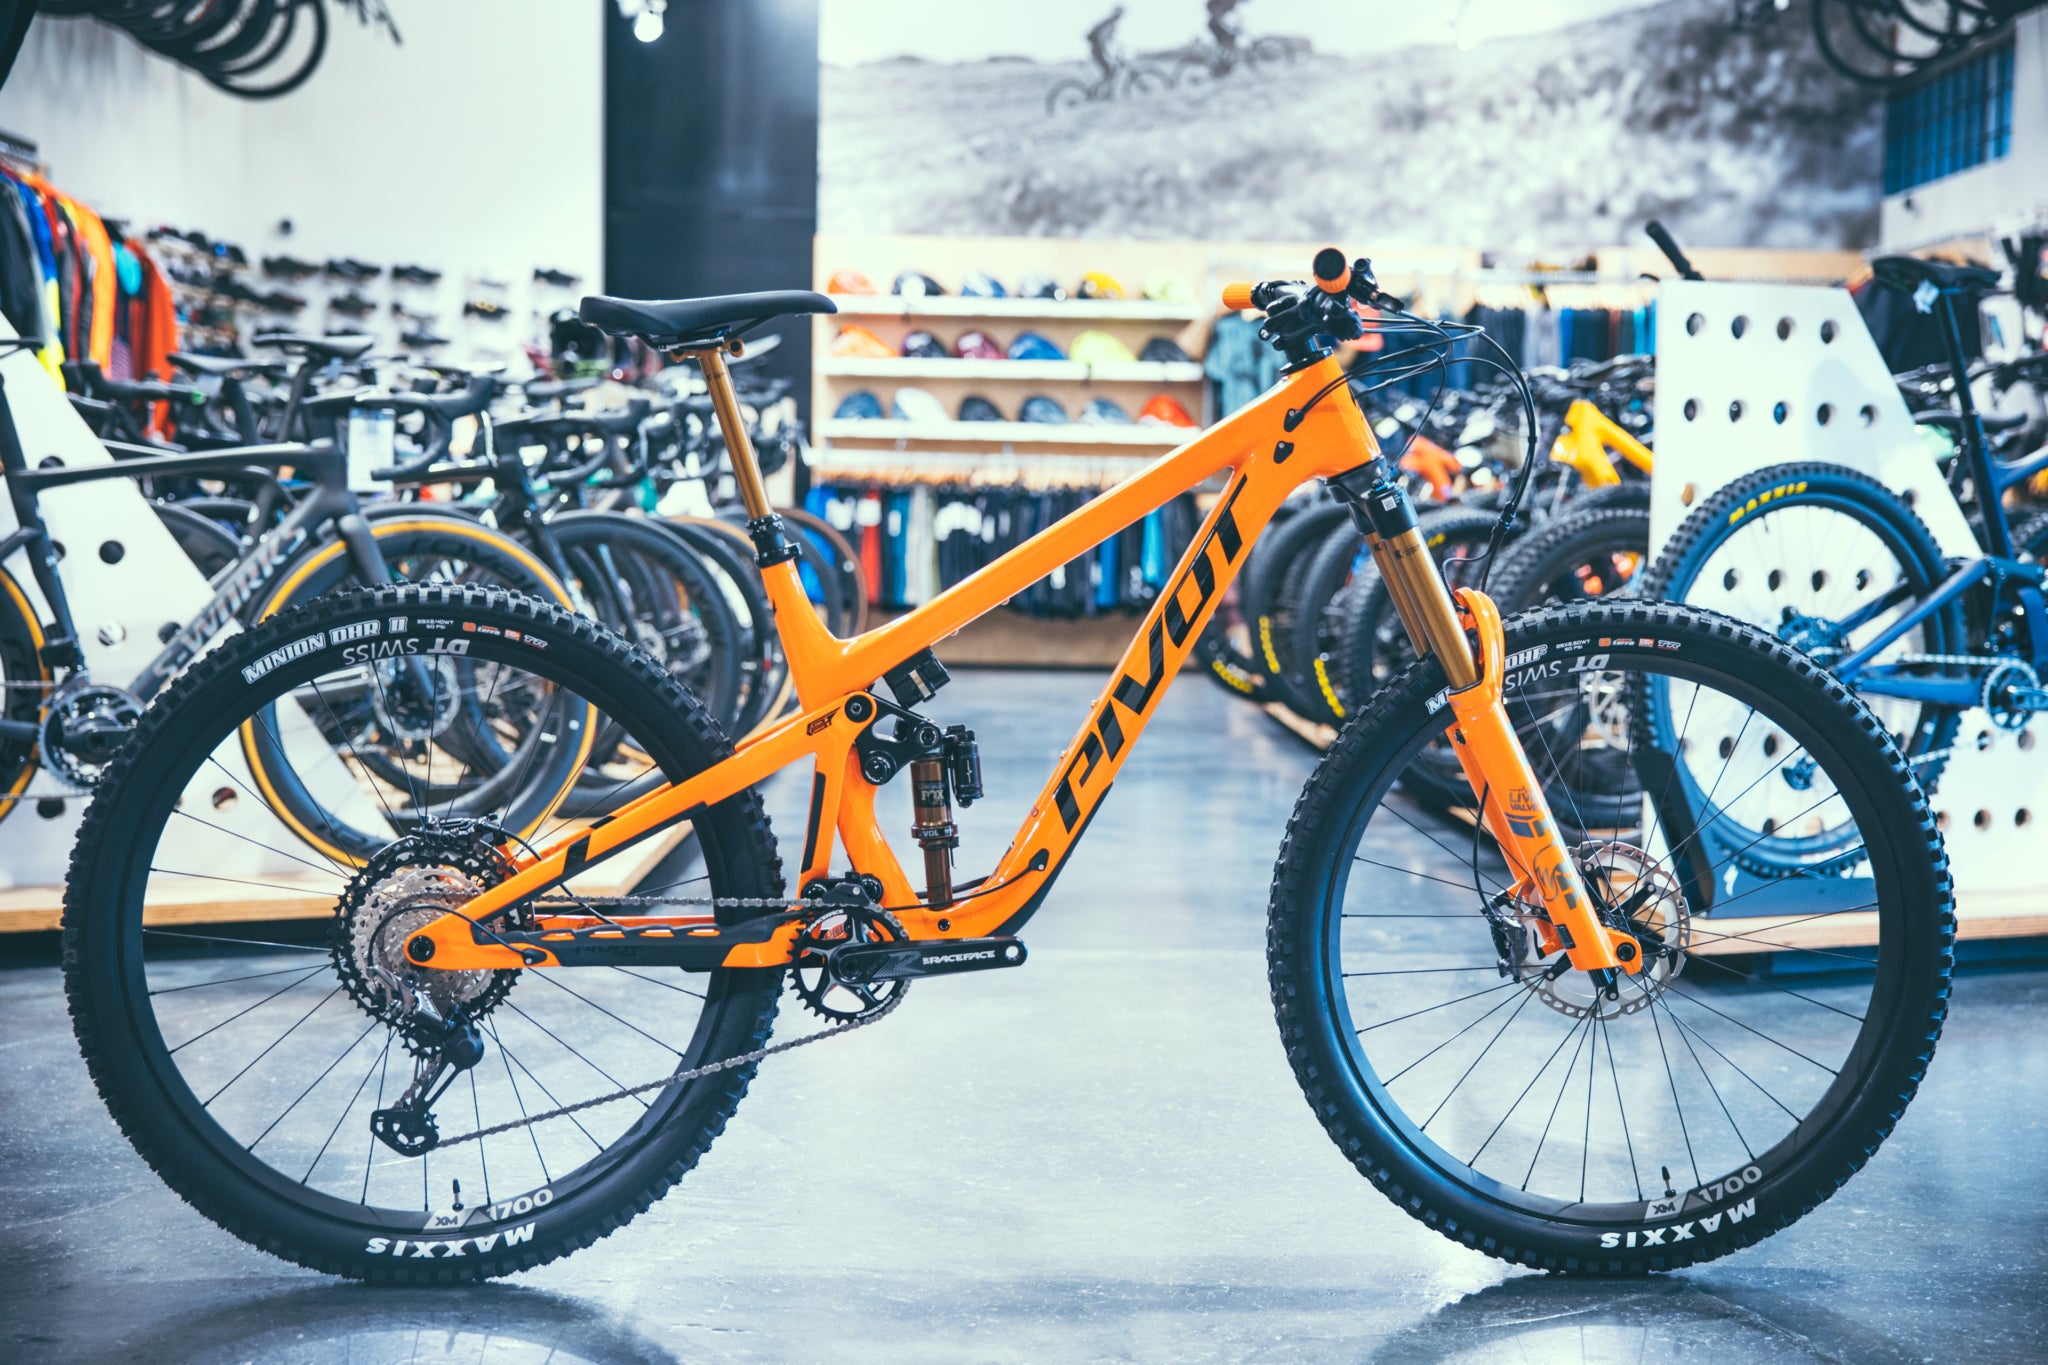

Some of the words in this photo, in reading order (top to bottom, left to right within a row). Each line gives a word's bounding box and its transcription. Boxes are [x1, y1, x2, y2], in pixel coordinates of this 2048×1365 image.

[241, 633, 326, 685] MINION
[328, 619, 381, 645] DHR
[388, 616, 408, 633] II
[342, 638, 419, 665] SWISS
[427, 637, 470, 655] DT
[1054, 473, 1247, 834] PIVOT
[1504, 644, 1548, 671] DHF
[1504, 660, 1562, 691] SWIS
[1568, 654, 1610, 673] DT
[929, 950, 996, 965] RACEFACE
[434, 1216, 458, 1227] XM
[486, 1188, 554, 1222] 1700
[1652, 1202, 1676, 1215] XM
[1699, 1166, 1763, 1203] 1700
[365, 1222, 536, 1259] MAXXIS
[1600, 1198, 1756, 1249] MAXXIS
